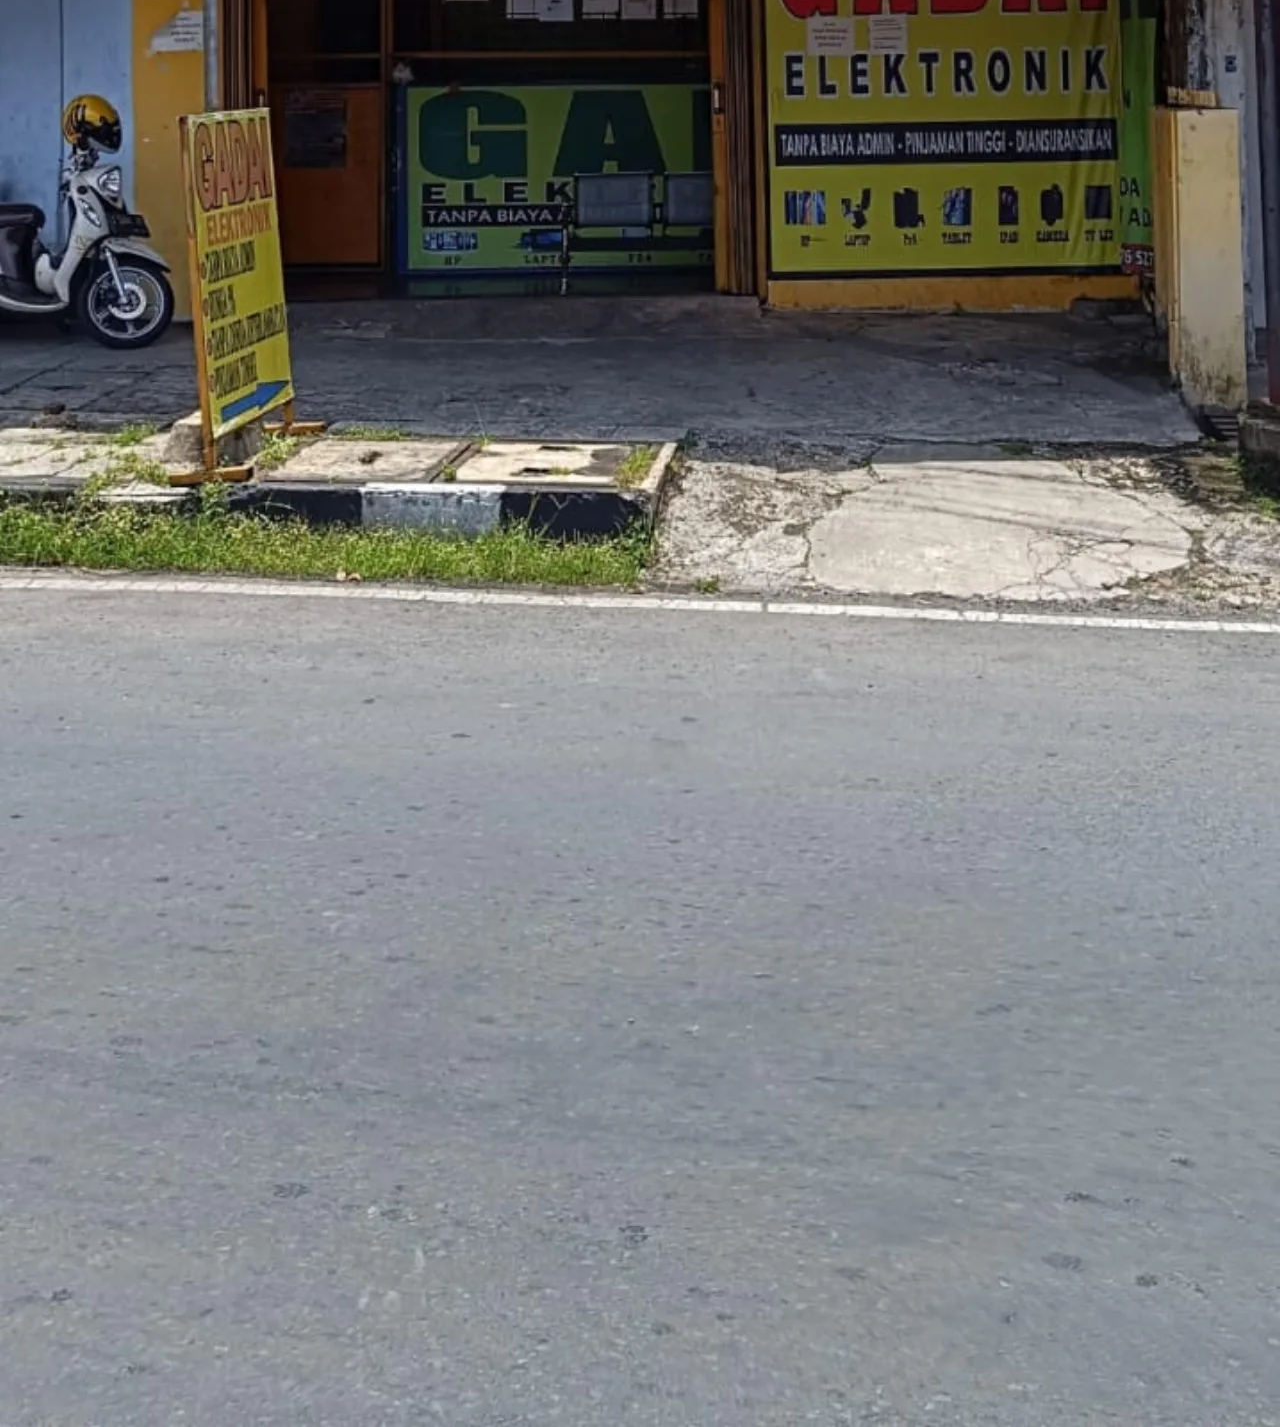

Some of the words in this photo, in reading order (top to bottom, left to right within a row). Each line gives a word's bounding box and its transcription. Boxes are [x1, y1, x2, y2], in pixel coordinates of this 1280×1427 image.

[784, 48, 1108, 96] ELEKTRONIK
[781, 133, 819, 157] TANPA
[820, 132, 855, 156] BIAYA
[857, 131, 895, 156] ADMIN
[904, 130, 964, 155] PINJAMAN
[966, 129, 1007, 154] TINGGI
[194, 116, 273, 212] GADAI
[427, 209, 492, 223] TANPA
[497, 208, 552, 223] BIAYA
